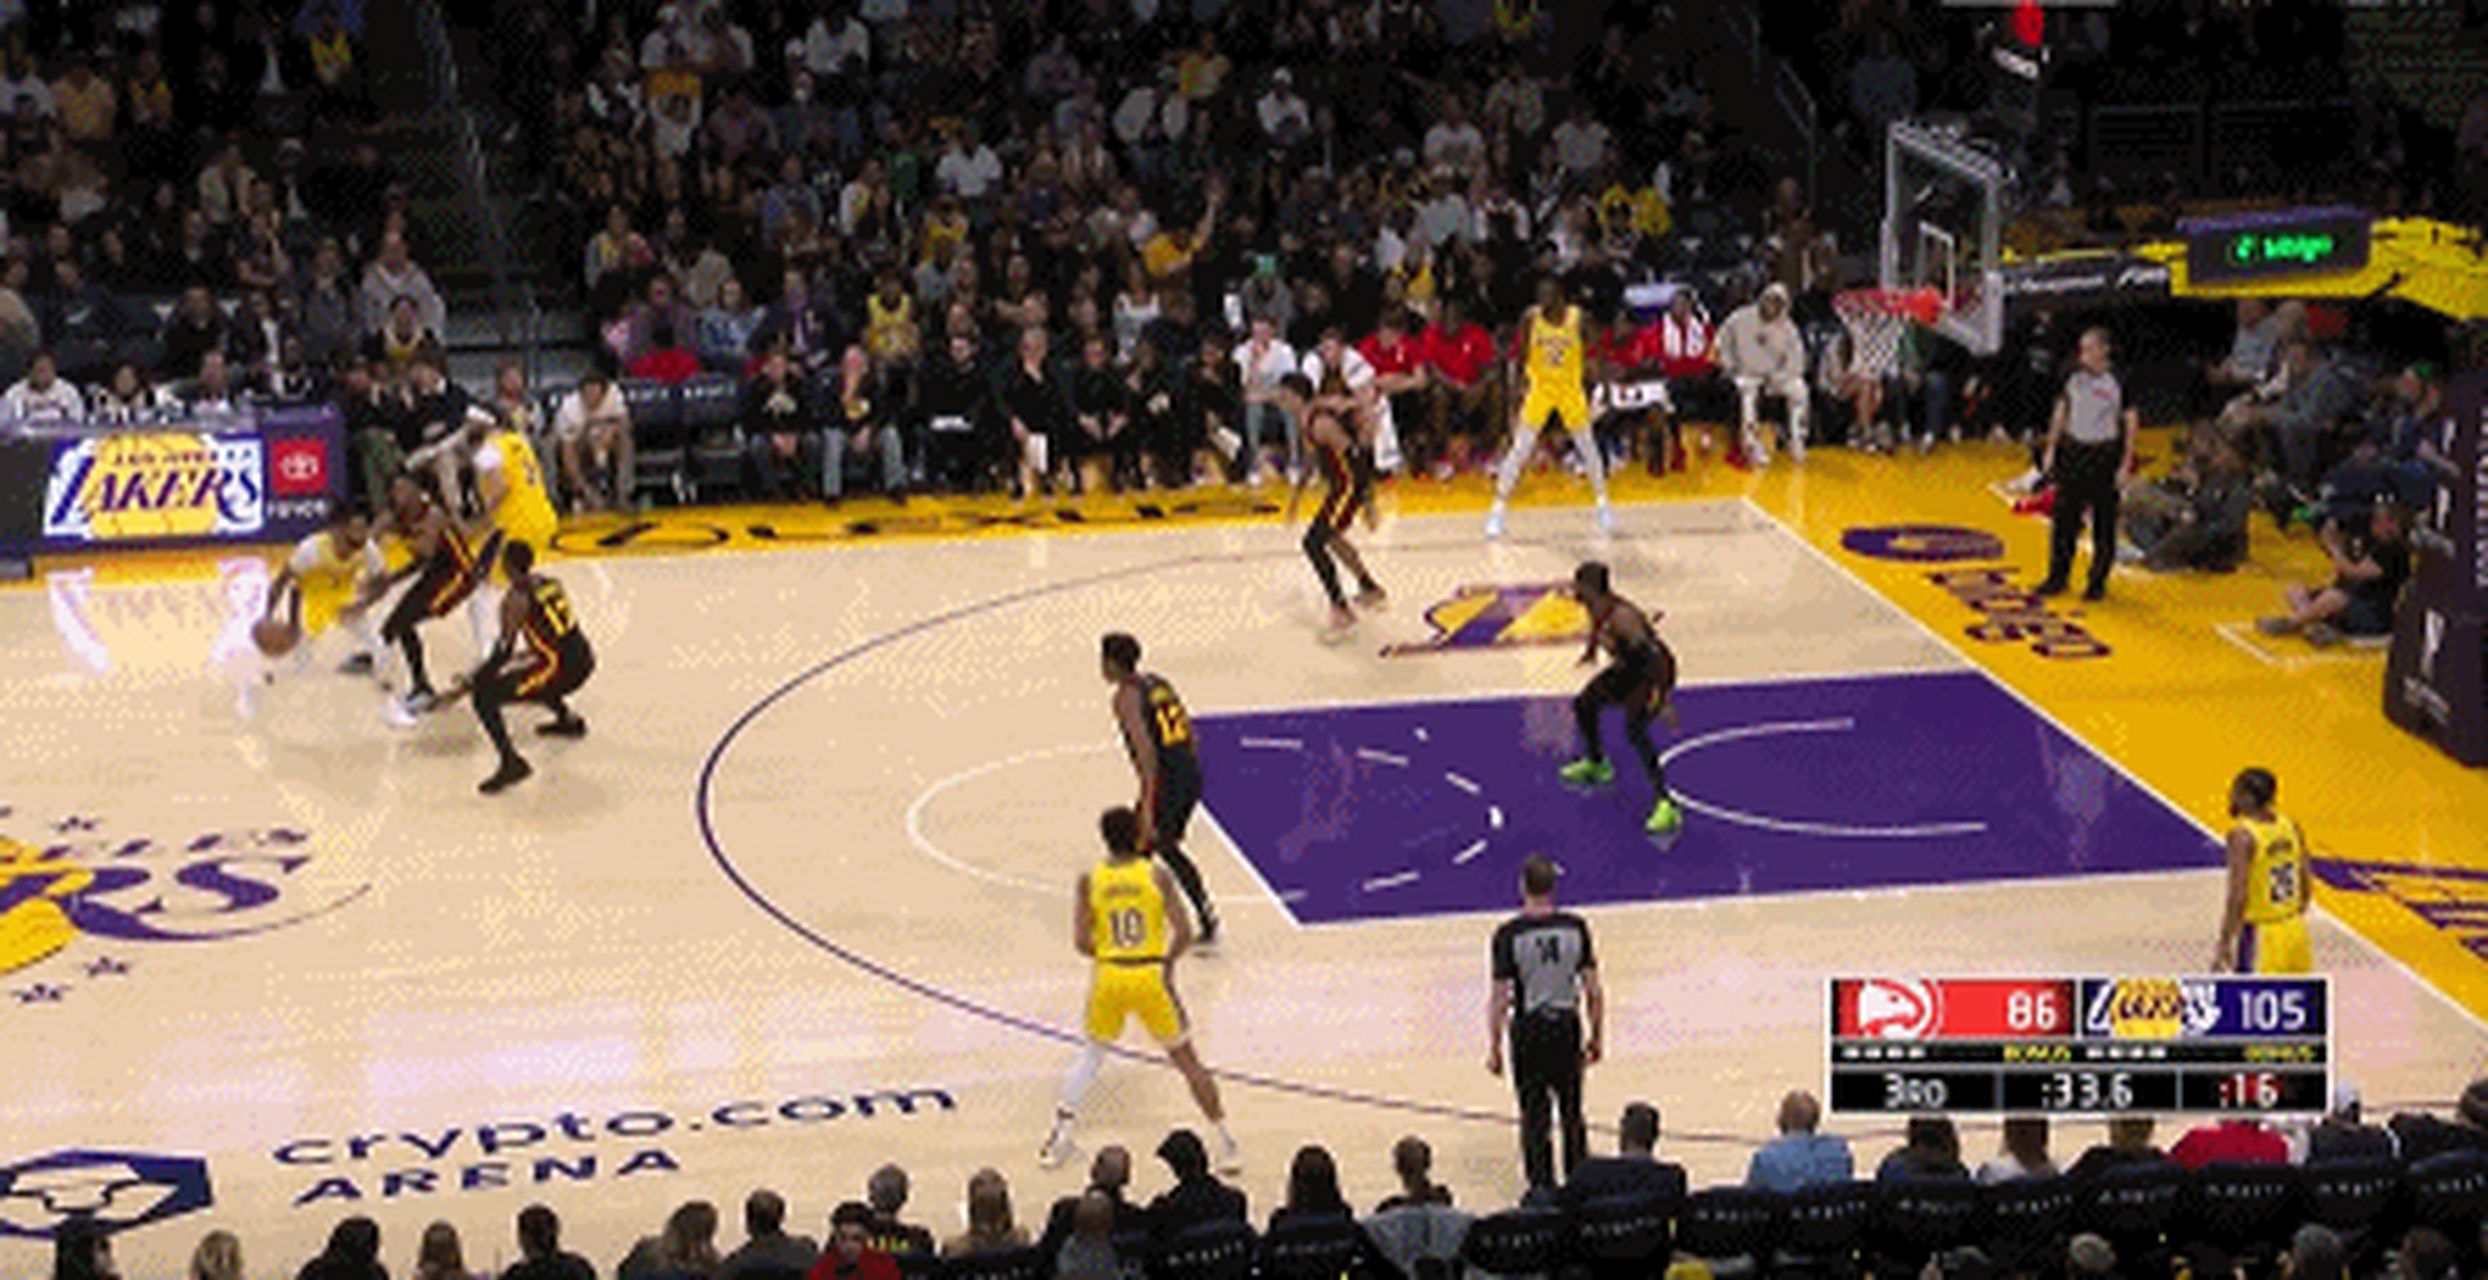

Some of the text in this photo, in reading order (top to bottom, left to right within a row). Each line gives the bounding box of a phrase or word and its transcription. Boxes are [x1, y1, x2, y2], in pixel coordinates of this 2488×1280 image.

[50, 455, 260, 525] LAKERS
[1109, 905, 1146, 947] 10
[272, 1088, 955, 1165] crypto.com
[293, 1148, 680, 1206] ARENA
